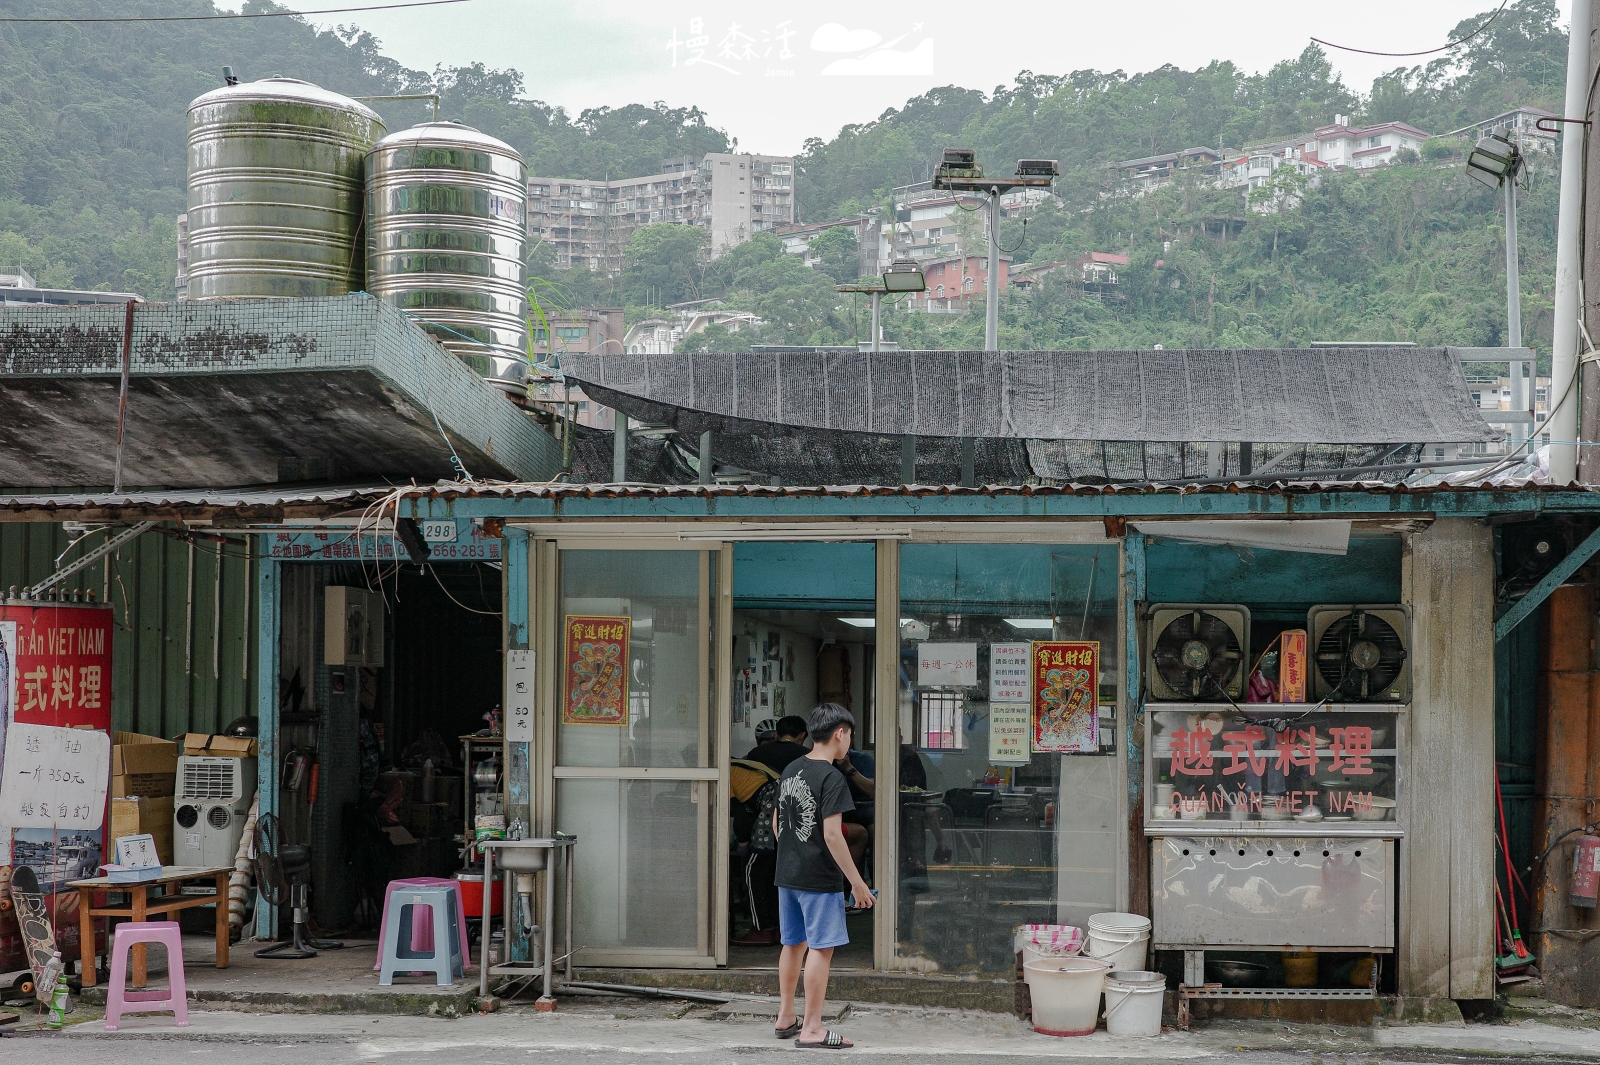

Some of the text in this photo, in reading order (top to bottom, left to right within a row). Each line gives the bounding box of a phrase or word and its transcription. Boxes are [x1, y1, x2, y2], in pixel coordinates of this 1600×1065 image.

[426, 525, 450, 538] 298
[78, 628, 104, 655] NAM
[921, 659, 975, 670] 每週一公休
[1170, 726, 1373, 776] 越式料理
[1329, 791, 1373, 813] NAM
